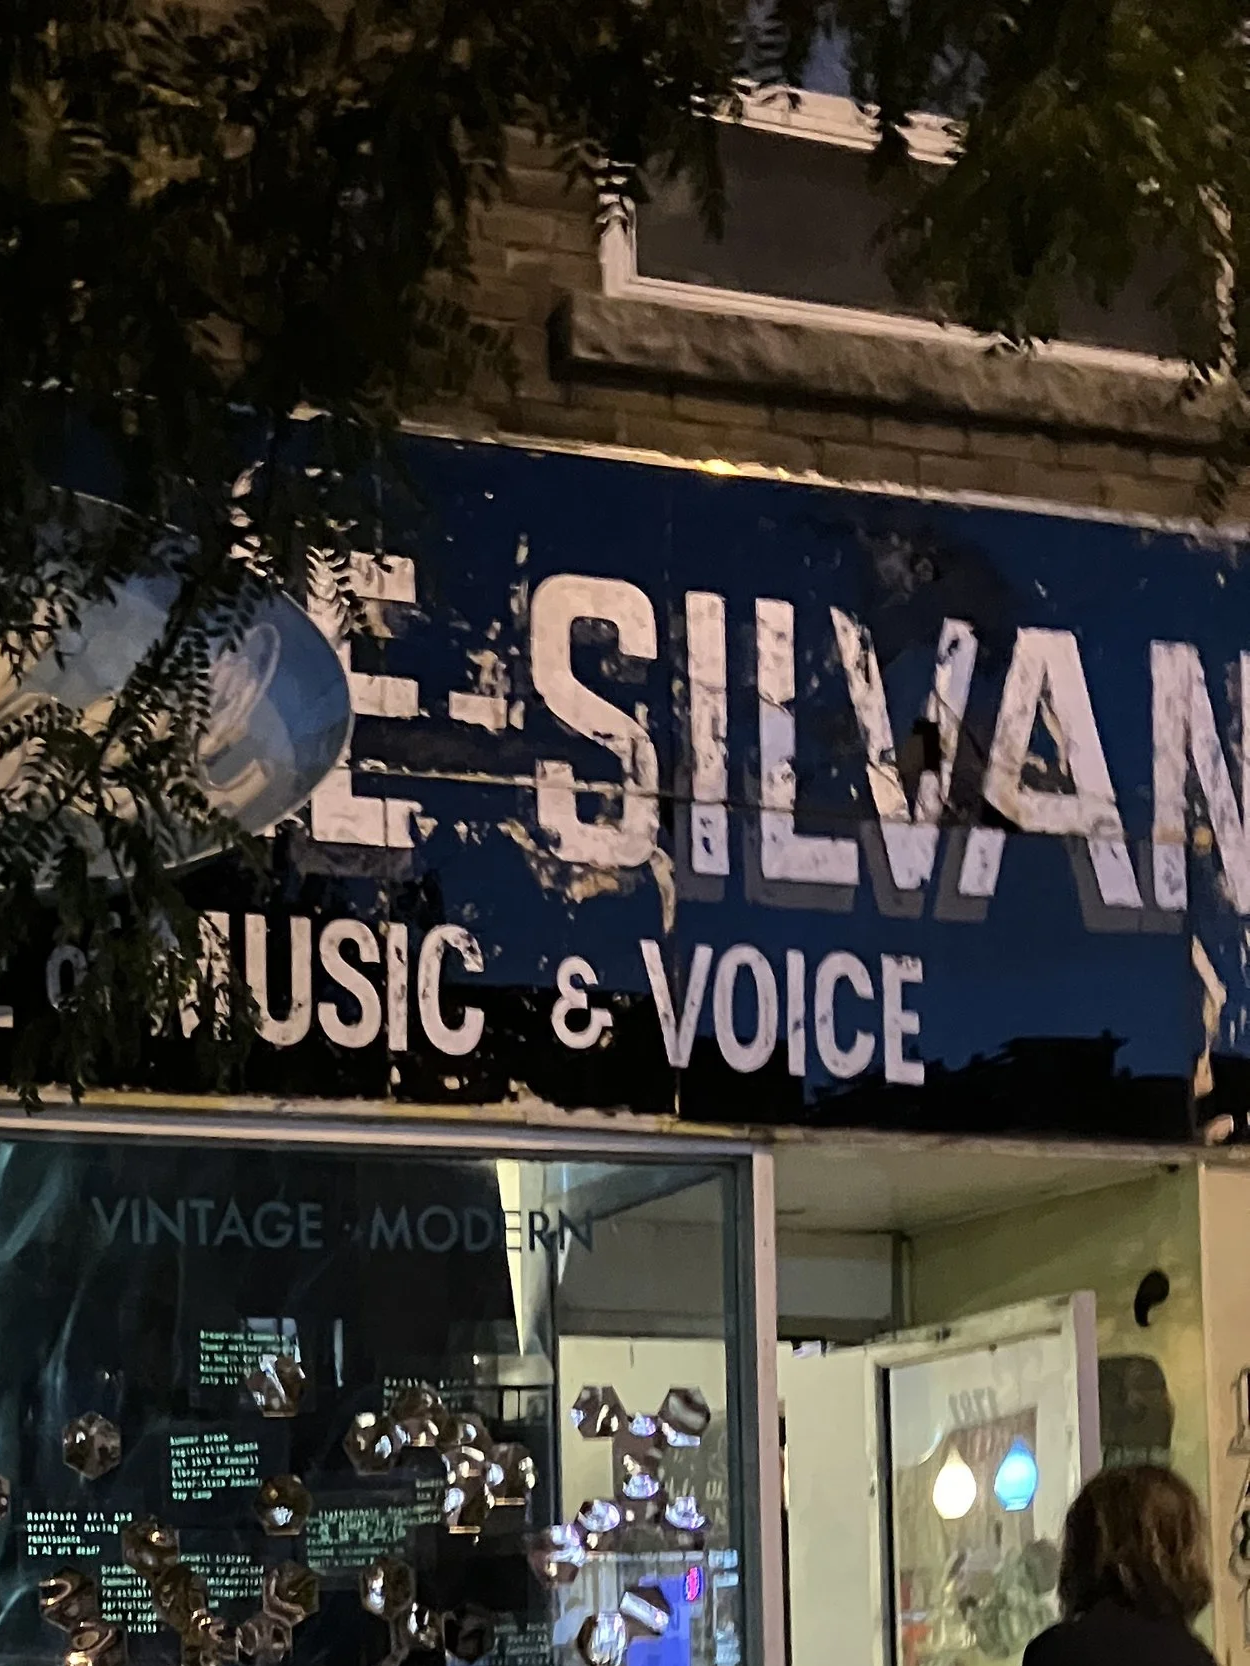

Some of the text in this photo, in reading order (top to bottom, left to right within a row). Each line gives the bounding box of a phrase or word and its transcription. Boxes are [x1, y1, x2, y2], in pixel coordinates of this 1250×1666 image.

[305, 547, 1250, 913] E-SILVAN
[553, 955, 612, 1048] &
[639, 938, 925, 1086] VOICE
[91, 1196, 596, 1254] VINTAGE MODERN
[171, 1445, 230, 1458] registration
[171, 1467, 206, 1479] Library
[26, 1511, 78, 1521] Handmade
[101, 1601, 153, 1612] agricultur
